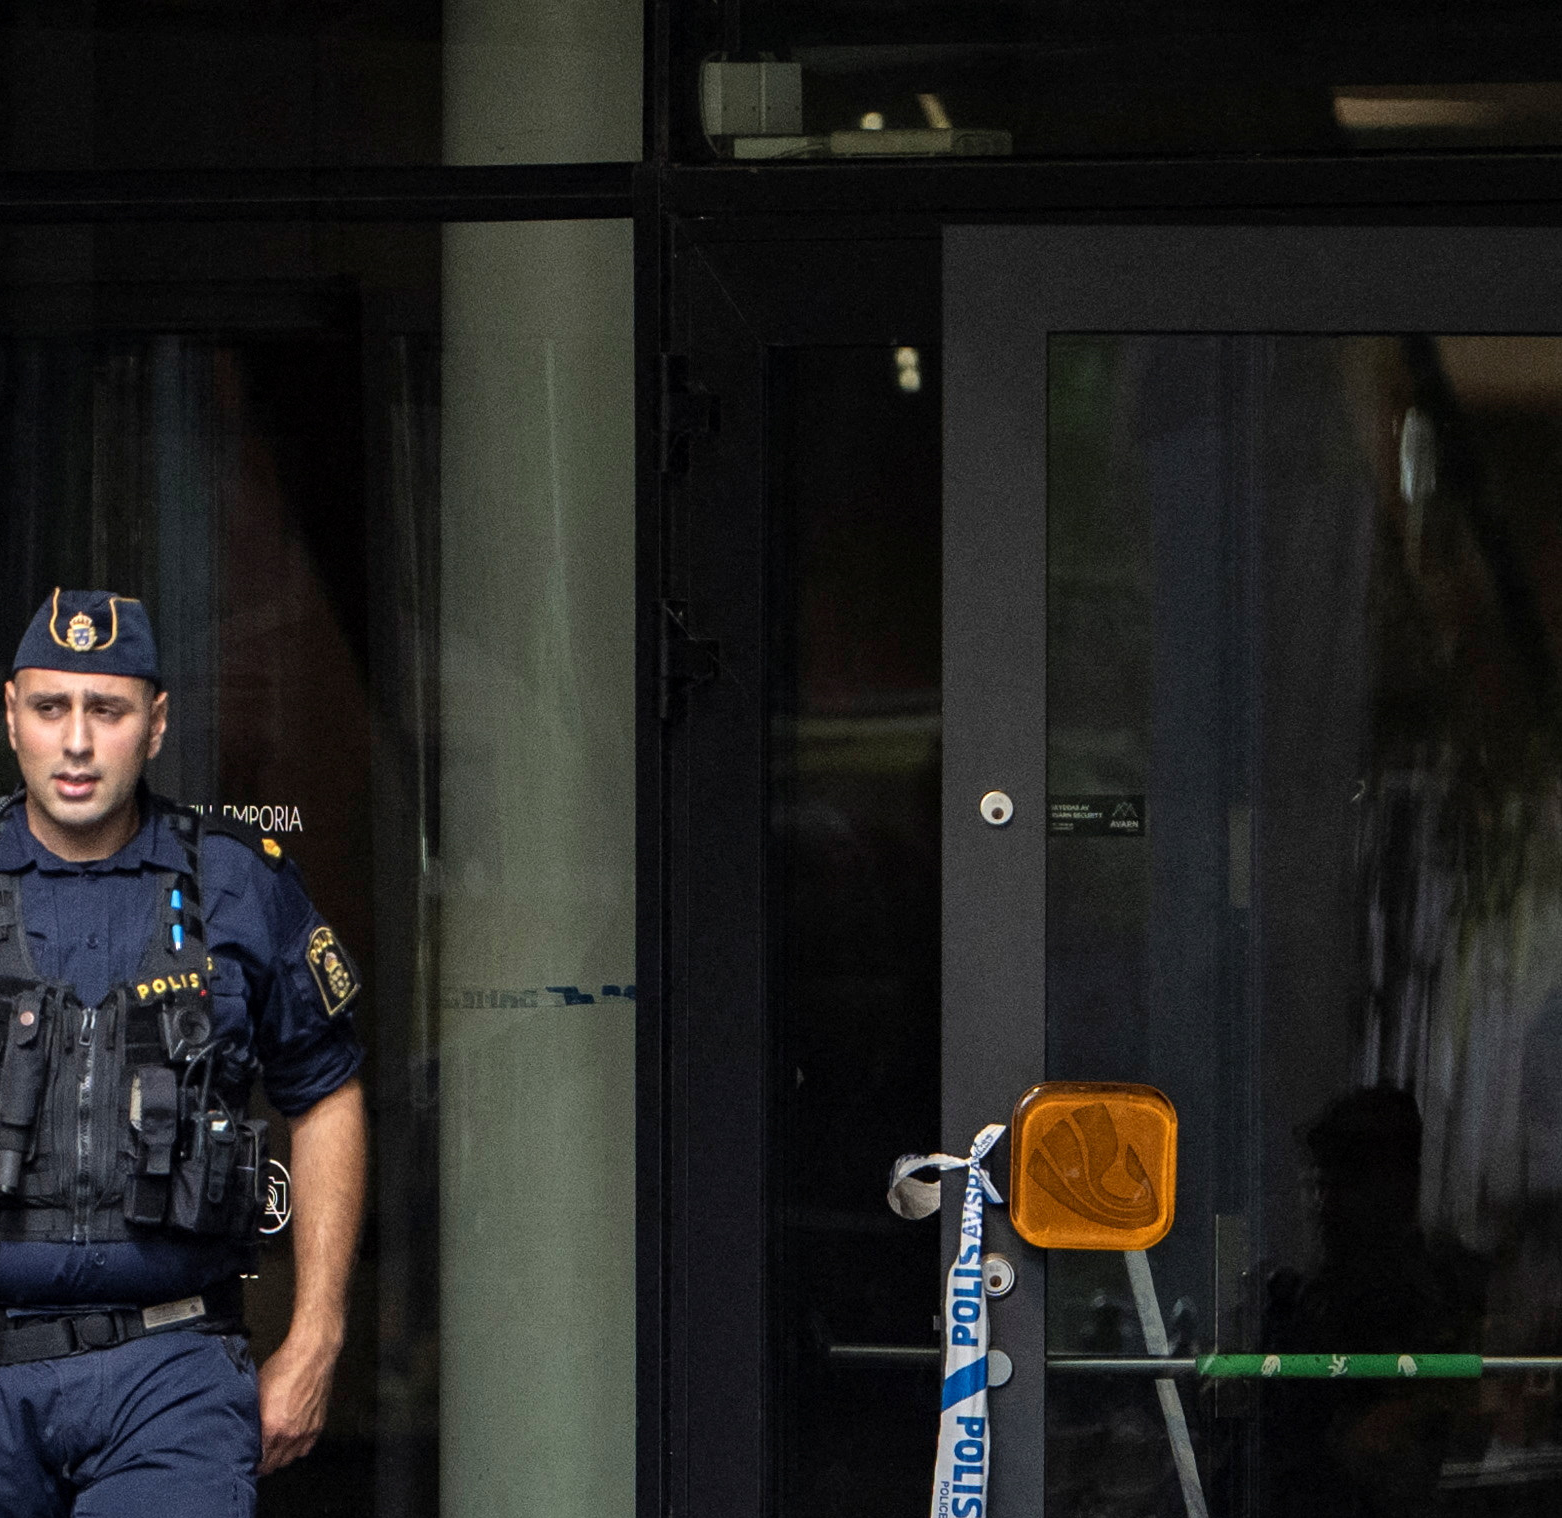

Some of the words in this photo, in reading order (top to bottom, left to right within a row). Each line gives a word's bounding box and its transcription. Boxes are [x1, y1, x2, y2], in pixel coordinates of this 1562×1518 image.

[1109, 820, 1139, 828] AVARN
[135, 971, 200, 1000] POLIS
[951, 1243, 982, 1347] POLIS
[951, 1415, 985, 1518] POLIS
